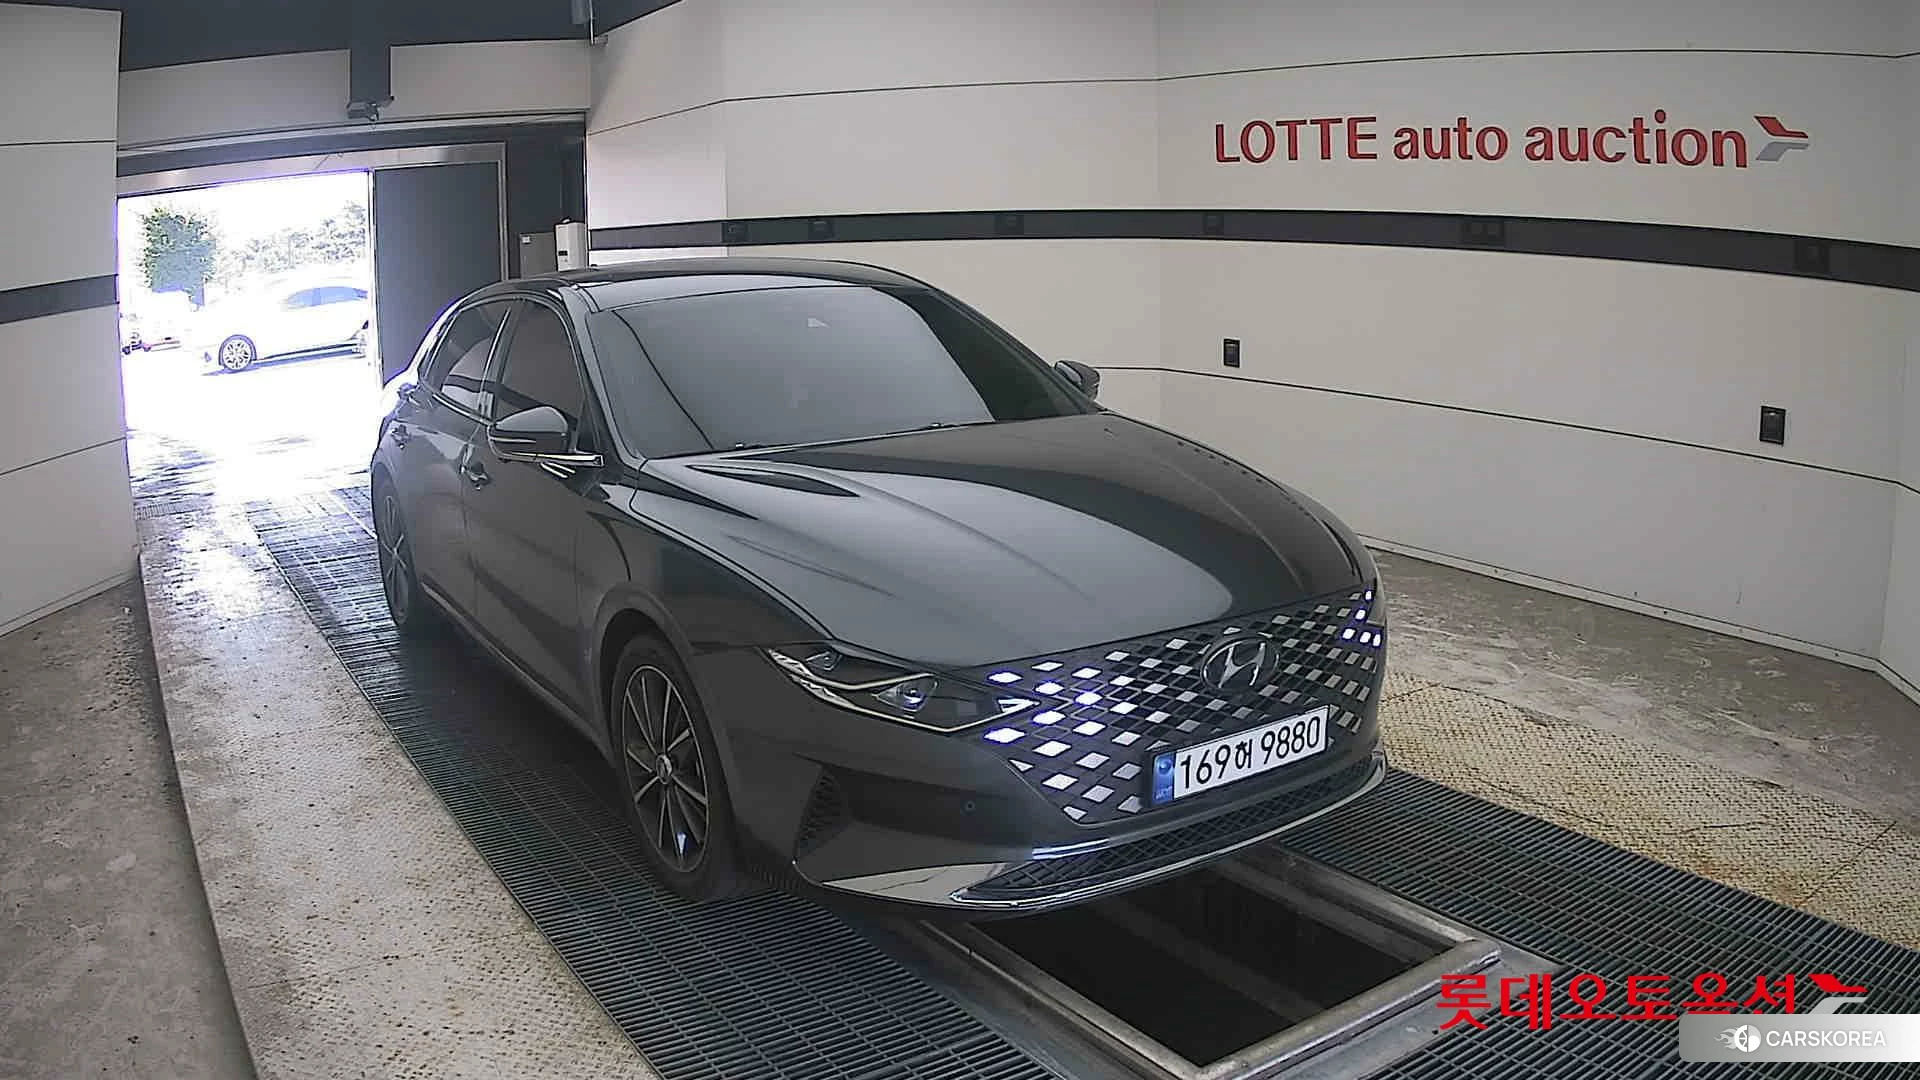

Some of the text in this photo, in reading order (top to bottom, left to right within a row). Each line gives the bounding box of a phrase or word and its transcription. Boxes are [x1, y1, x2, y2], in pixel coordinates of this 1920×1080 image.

[1215, 109, 1748, 168] LOTTE auto auction
